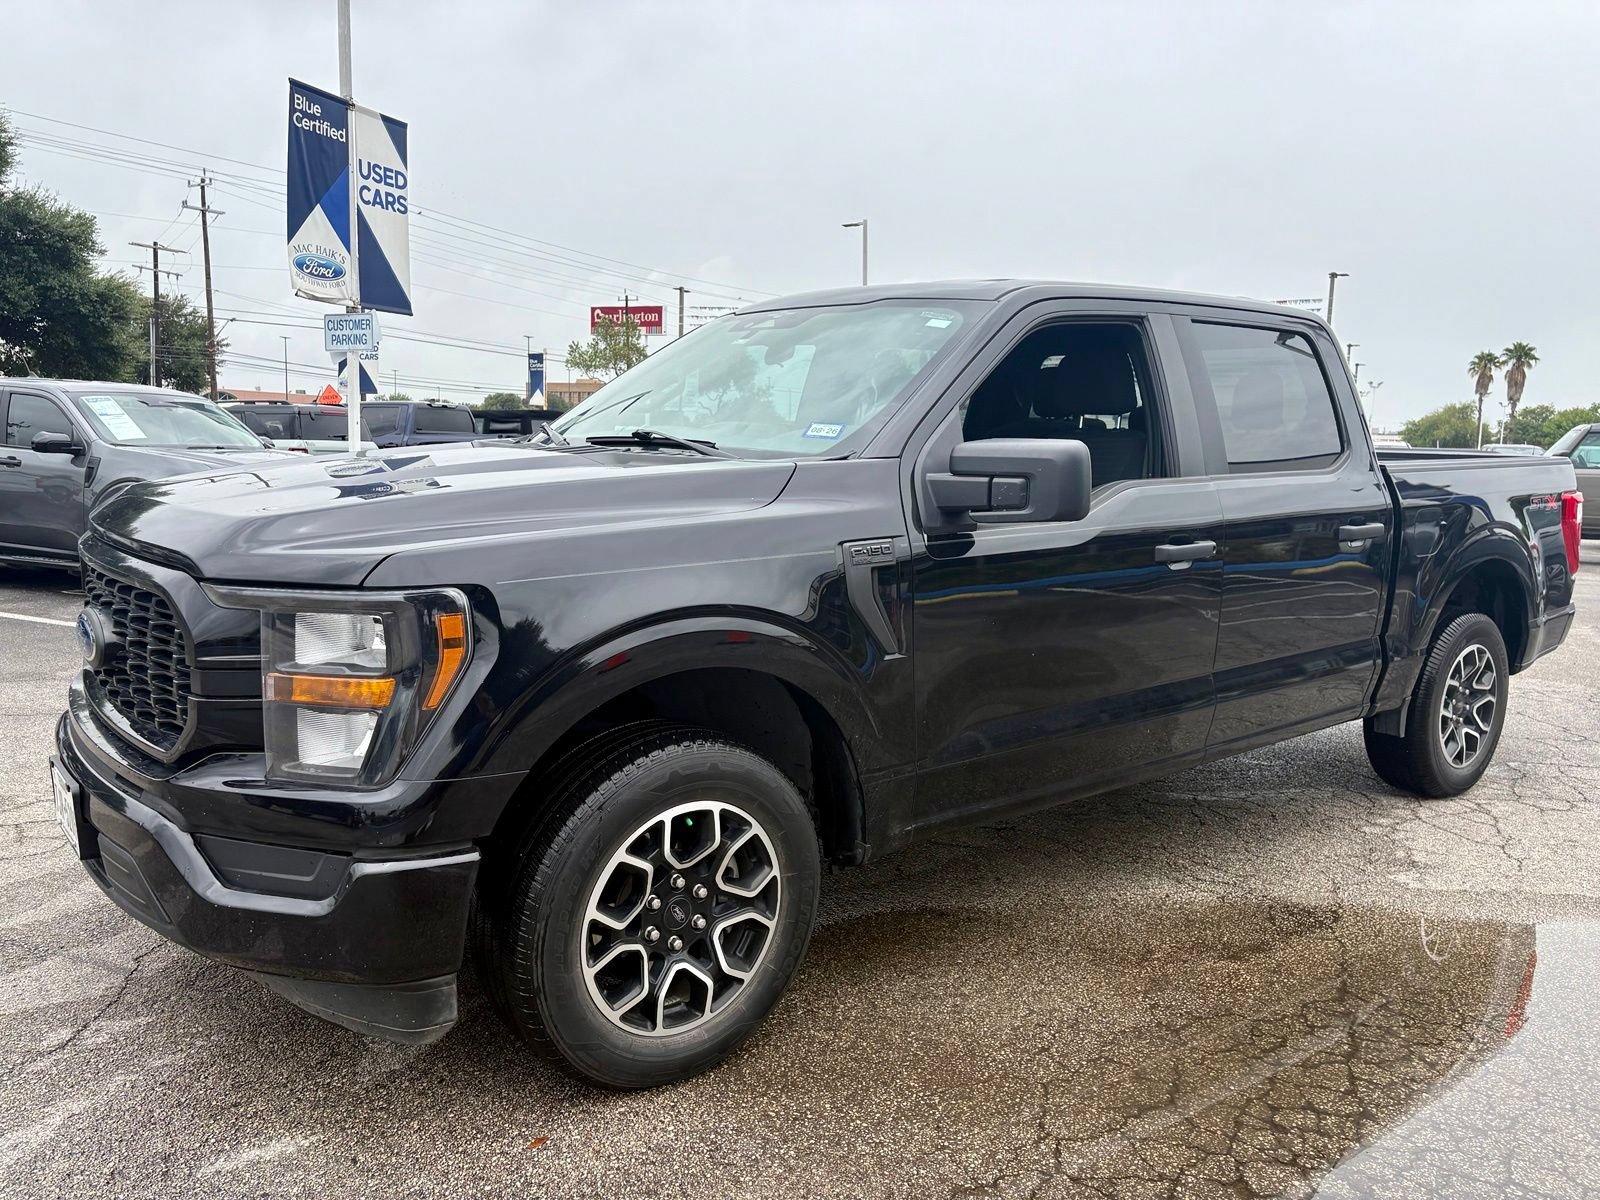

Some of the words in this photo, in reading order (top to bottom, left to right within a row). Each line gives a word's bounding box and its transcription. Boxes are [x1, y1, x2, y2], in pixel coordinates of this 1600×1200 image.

[294, 93, 321, 117] Blue
[292, 112, 346, 143] Certified
[358, 158, 408, 191] USED
[358, 184, 408, 215] CARS
[293, 244, 313, 255] MAC
[316, 245, 347, 265] HAIK'S
[303, 257, 335, 278] Ford
[294, 272, 328, 289] SOUTHWAY
[329, 279, 346, 289] FORD
[326, 318, 371, 332] CUSTOMER
[331, 333, 368, 346] PARKING
[359, 353, 379, 361] CARS
[1530, 495, 1557, 510] STX
[850, 544, 893, 558] F-150
